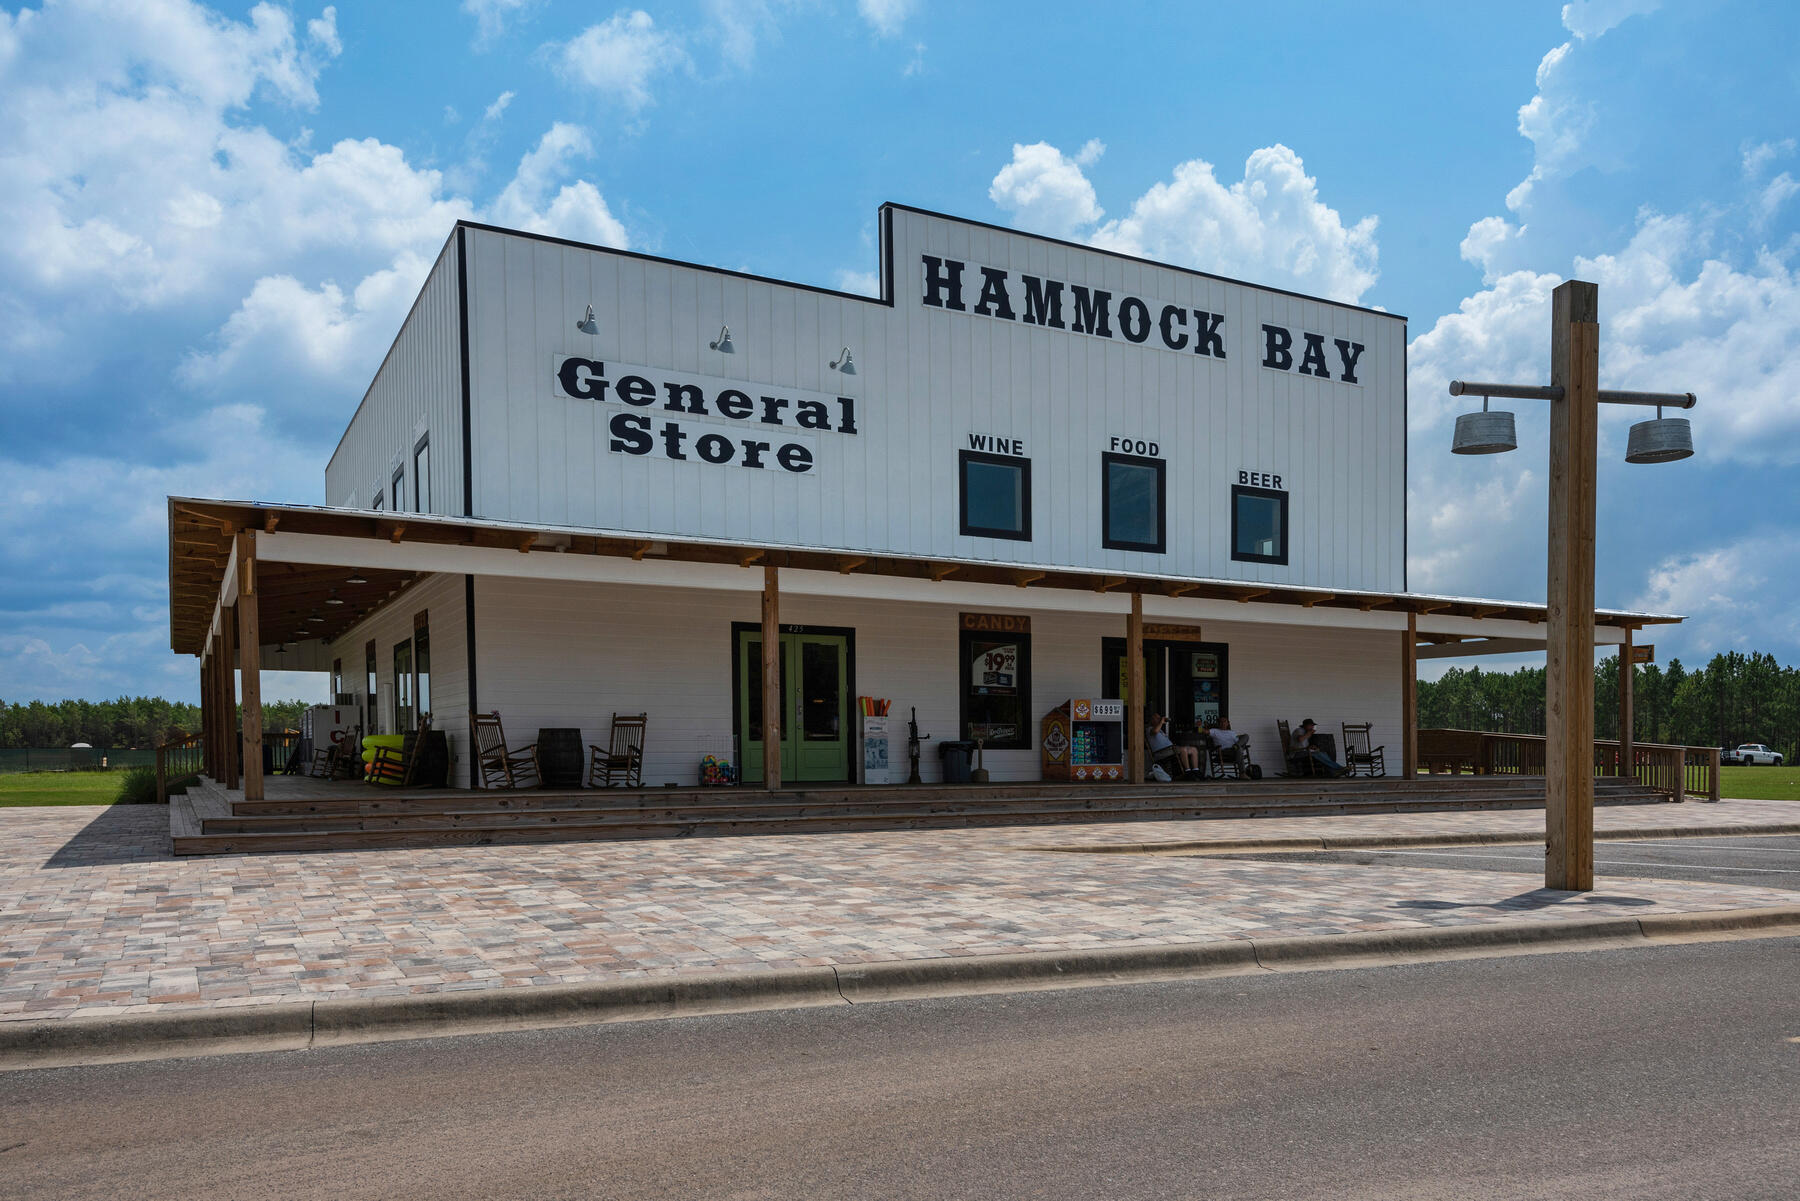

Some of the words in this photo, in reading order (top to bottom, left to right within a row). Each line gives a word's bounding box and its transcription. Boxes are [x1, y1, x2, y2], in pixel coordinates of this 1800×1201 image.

[921, 254, 1227, 359] HAMMOCK
[1261, 323, 1365, 385] BAY
[556, 357, 858, 435] General
[609, 413, 813, 473] Store
[968, 433, 1024, 456] WINE
[1110, 436, 1160, 457] FOOD
[1238, 470, 1283, 490] BEER
[965, 614, 1026, 631] CANDY
